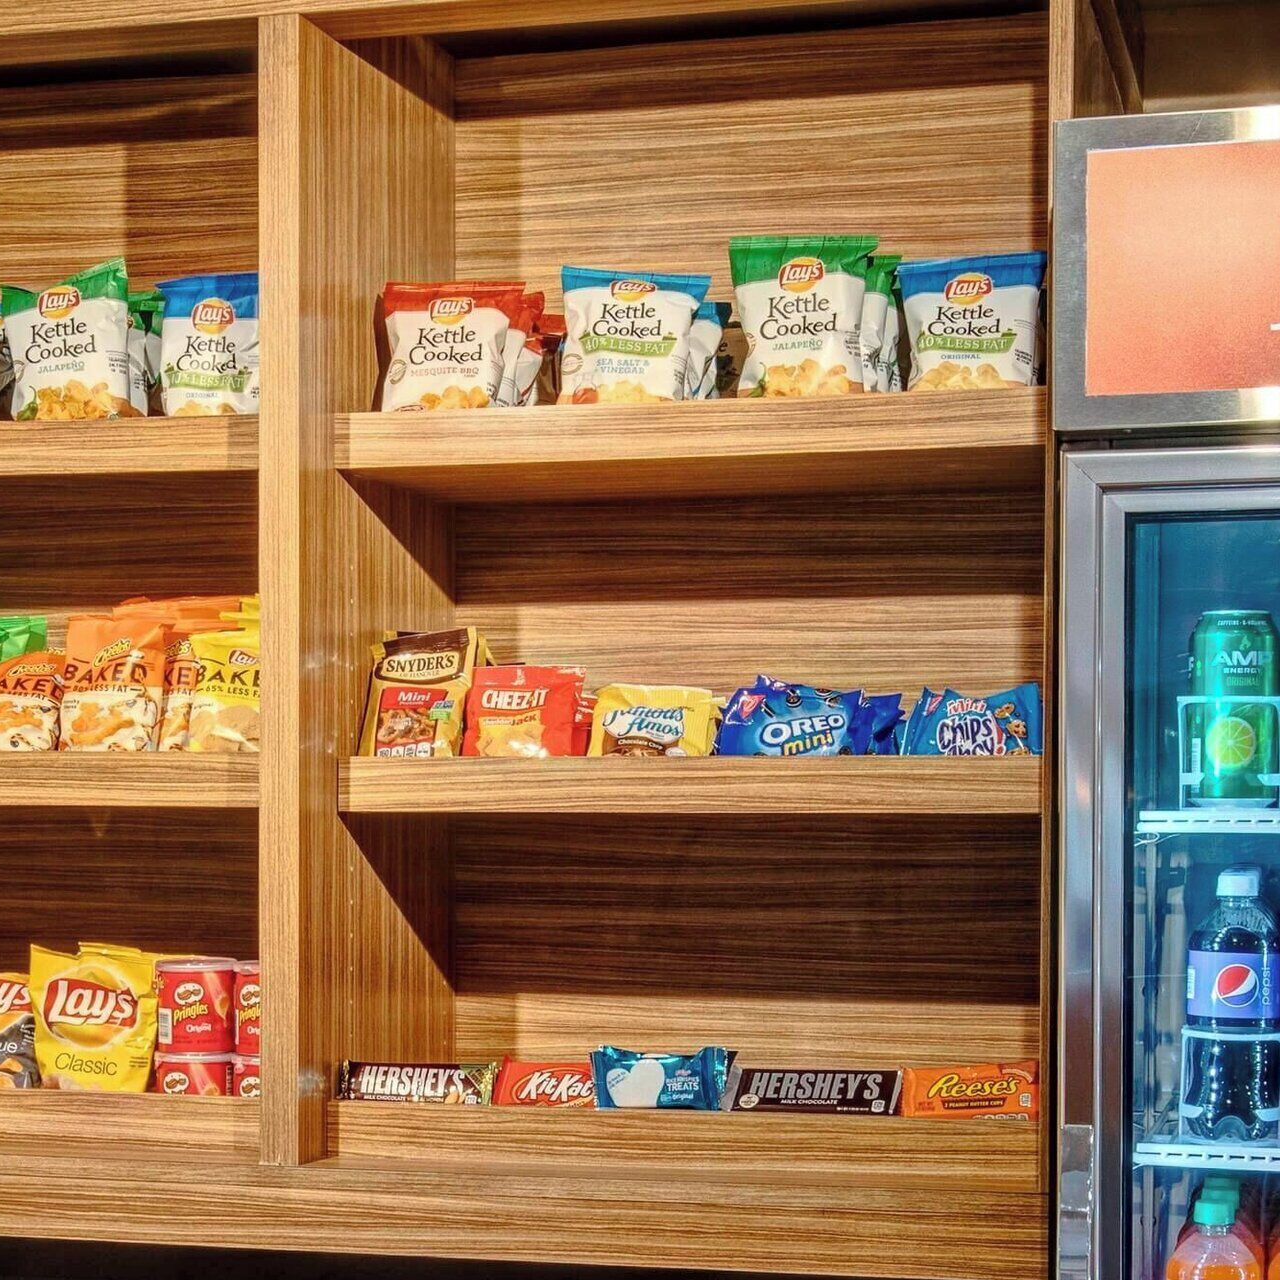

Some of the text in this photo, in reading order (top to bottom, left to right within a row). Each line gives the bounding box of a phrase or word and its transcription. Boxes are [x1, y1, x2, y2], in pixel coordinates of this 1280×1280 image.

[781, 261, 821, 284] Lay's
[946, 277, 991, 297] Lay's
[39, 290, 78, 313] Lay's
[430, 298, 472, 317] Lay's
[602, 303, 655, 321] Kettle
[767, 293, 829, 320] Kettle
[193, 303, 232, 324] Lay's
[935, 304, 994, 323] Kettle
[30, 318, 87, 345] Kettle
[417, 325, 476, 348] Kettle
[592, 318, 662, 338] Cooked
[759, 312, 837, 340] Cooked
[927, 319, 1000, 338] Cooked
[25, 335, 96, 364] Cooked
[185, 335, 235, 356] Kettle
[585, 337, 668, 353] 40% LESS FAT
[946, 337, 980, 349] LESS
[983, 338, 1006, 350] FAT
[176, 353, 237, 374] Cooked
[409, 345, 483, 365] Cooked
[940, 352, 982, 360] ORIGINAL
[386, 654, 455, 673] SNYDER'S
[1212, 650, 1273, 666] AMP
[64, 664, 148, 685] BAKED
[110, 685, 128, 693] FAT
[227, 686, 249, 697] LESS
[398, 691, 431, 702] Mini
[618, 717, 684, 736] Amos
[760, 713, 846, 744] OREO
[938, 715, 994, 752] Chips
[783, 733, 833, 755] mini
[48, 979, 134, 1024] Lay's
[173, 1002, 209, 1026] Pringles
[55, 1053, 118, 1076] Classic
[361, 1065, 465, 1097] HERSHEY'S
[666, 1082, 700, 1092] TREATS
[749, 1072, 883, 1100] HERSHEY'S
[928, 1074, 1020, 1098] Reese's
